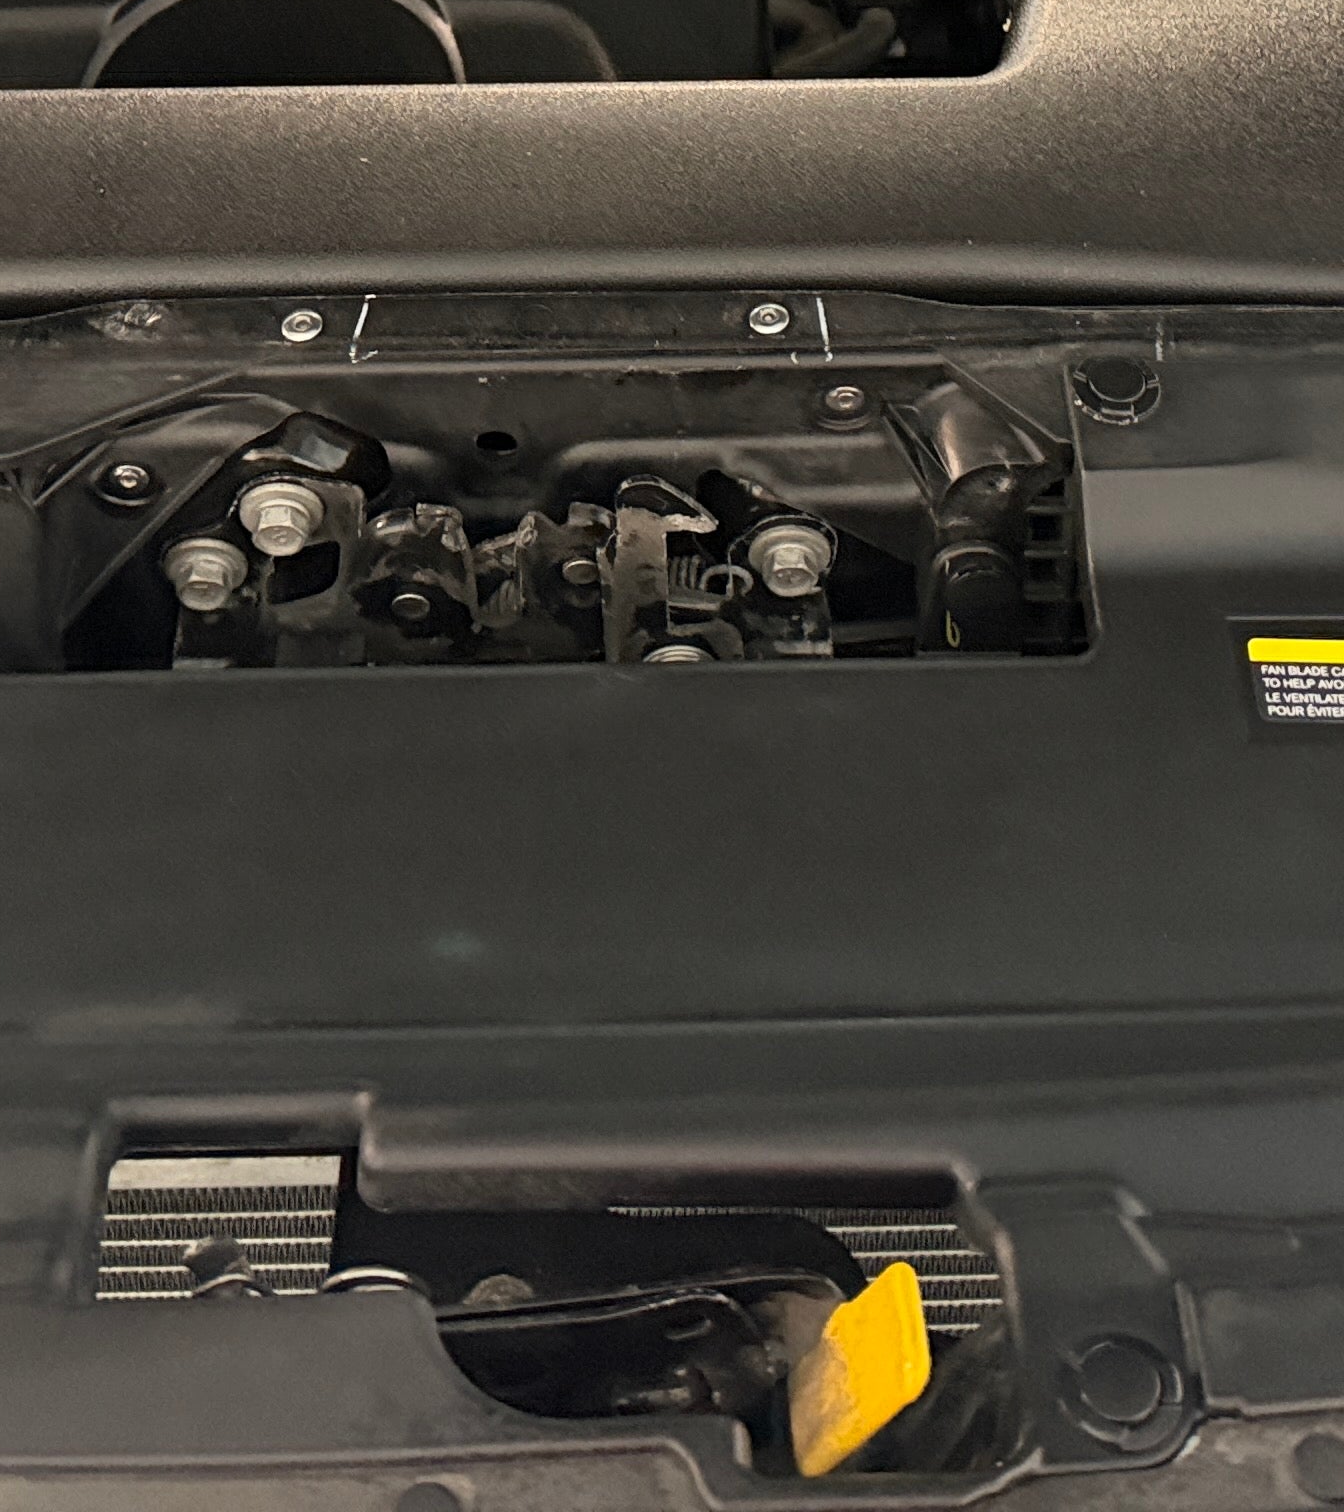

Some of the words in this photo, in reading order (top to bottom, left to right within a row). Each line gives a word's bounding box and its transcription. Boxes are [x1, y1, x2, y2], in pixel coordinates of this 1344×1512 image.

[1260, 665, 1285, 676] FAN
[1288, 665, 1329, 677] BLADE
[1262, 678, 1280, 689] TO
[1283, 678, 1316, 690] HELP
[1264, 692, 1282, 704] LE
[1267, 705, 1305, 717] POUR
